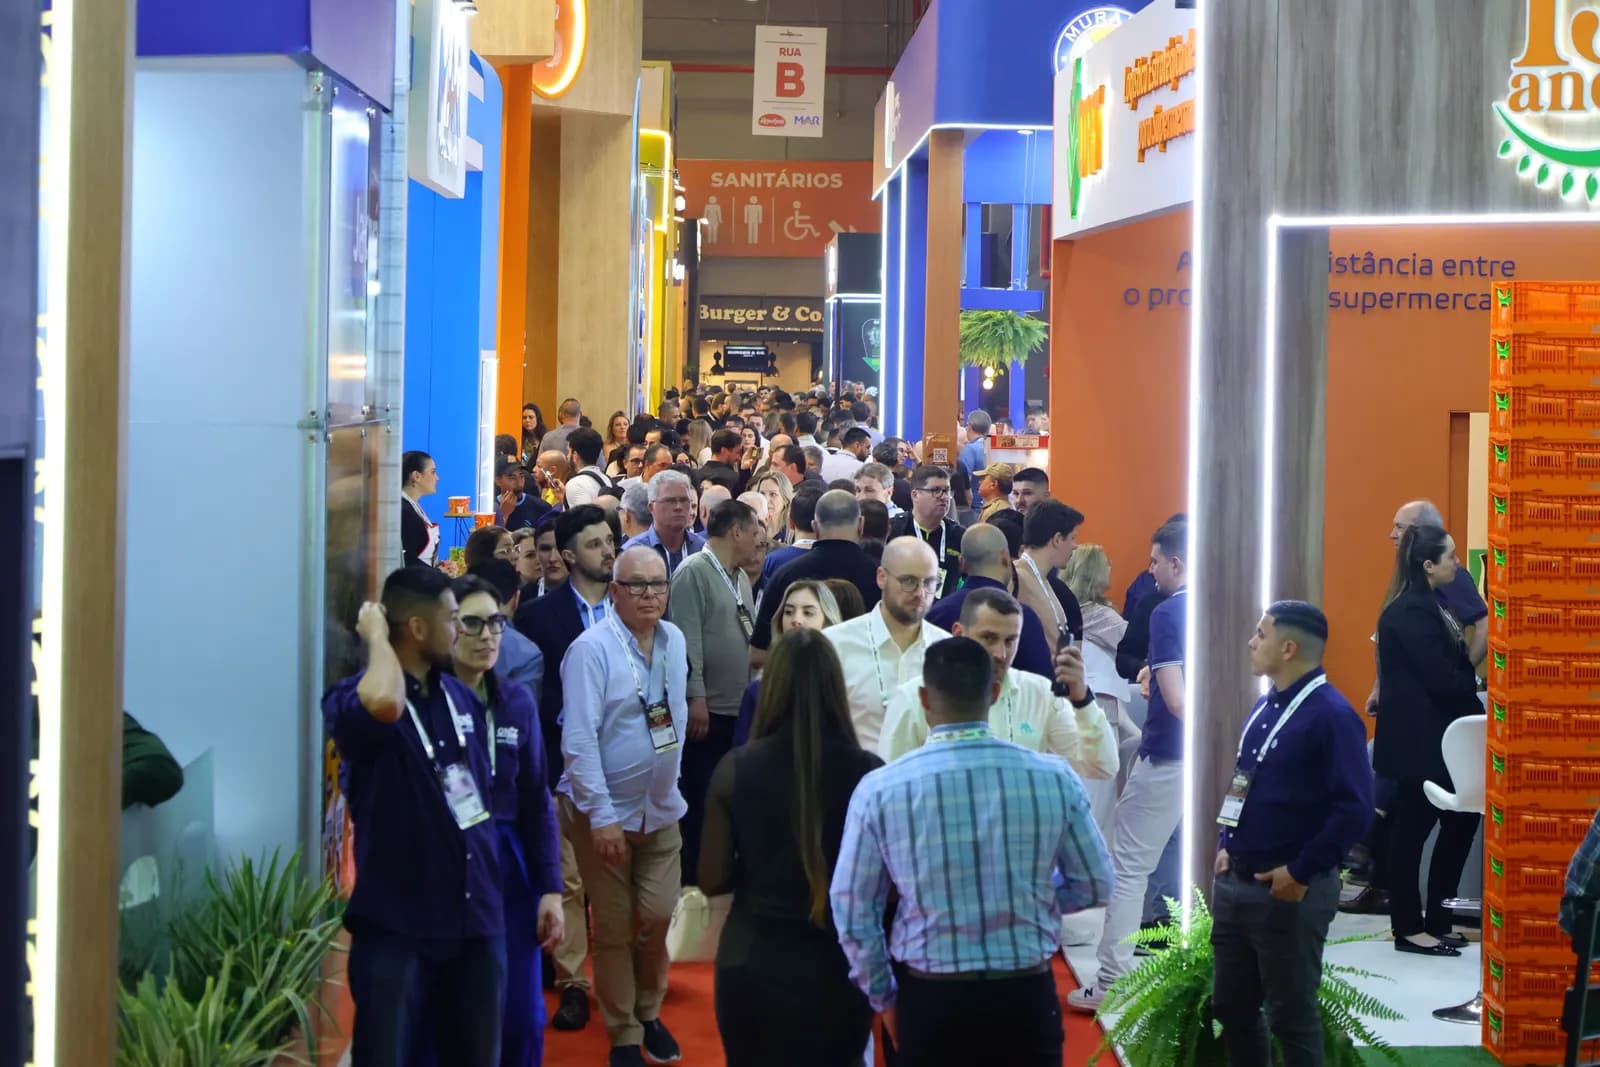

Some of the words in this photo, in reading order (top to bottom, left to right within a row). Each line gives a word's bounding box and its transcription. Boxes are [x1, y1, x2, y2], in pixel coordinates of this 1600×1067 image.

[779, 47, 802, 57] RUA
[776, 62, 805, 98] B
[794, 115, 820, 126] MAR
[711, 168, 843, 188] SANITÁRIOS
[1442, 255, 1516, 278] entre
[1123, 287, 1140, 306] o
[1328, 291, 1492, 314] supermerca
[700, 304, 767, 324] Burger
[772, 305, 790, 321] &
